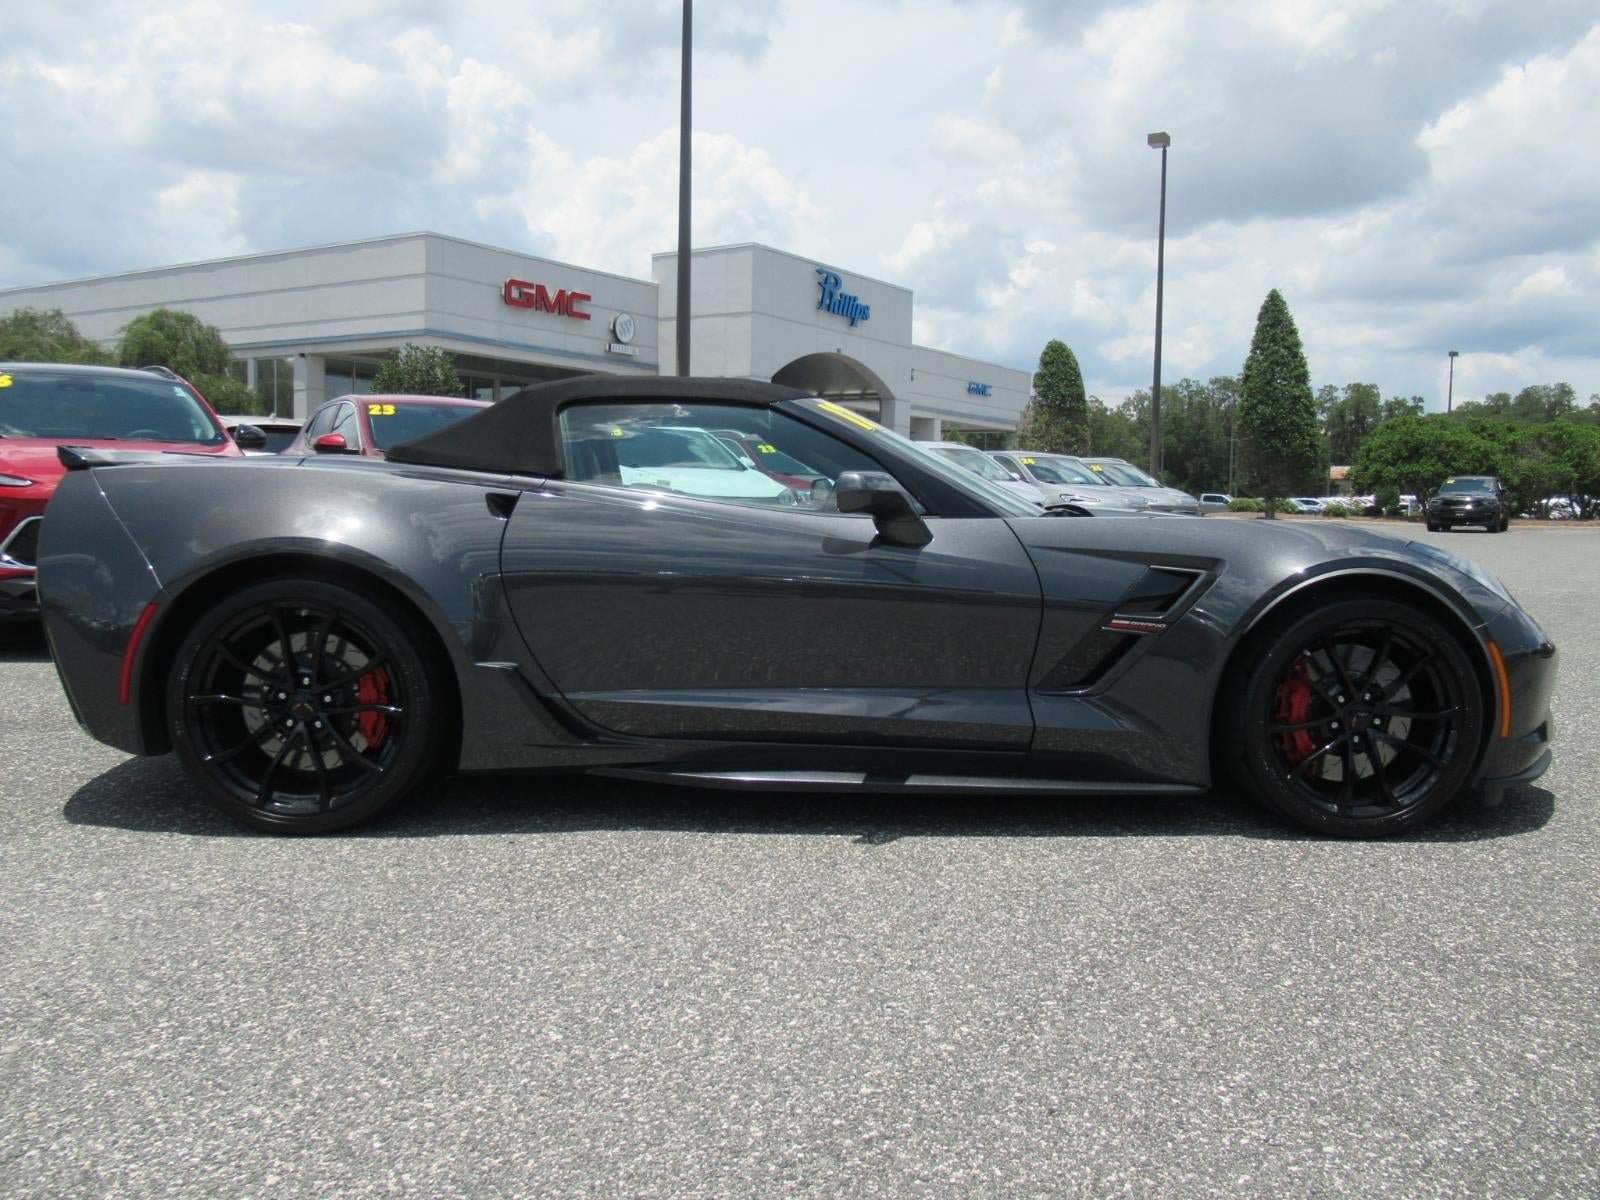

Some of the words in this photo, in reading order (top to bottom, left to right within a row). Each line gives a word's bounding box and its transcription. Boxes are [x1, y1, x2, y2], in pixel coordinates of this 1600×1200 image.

[504, 278, 592, 321] GMC
[816, 268, 871, 328] Phillips
[967, 381, 993, 397] GMC
[368, 403, 396, 416] 23
